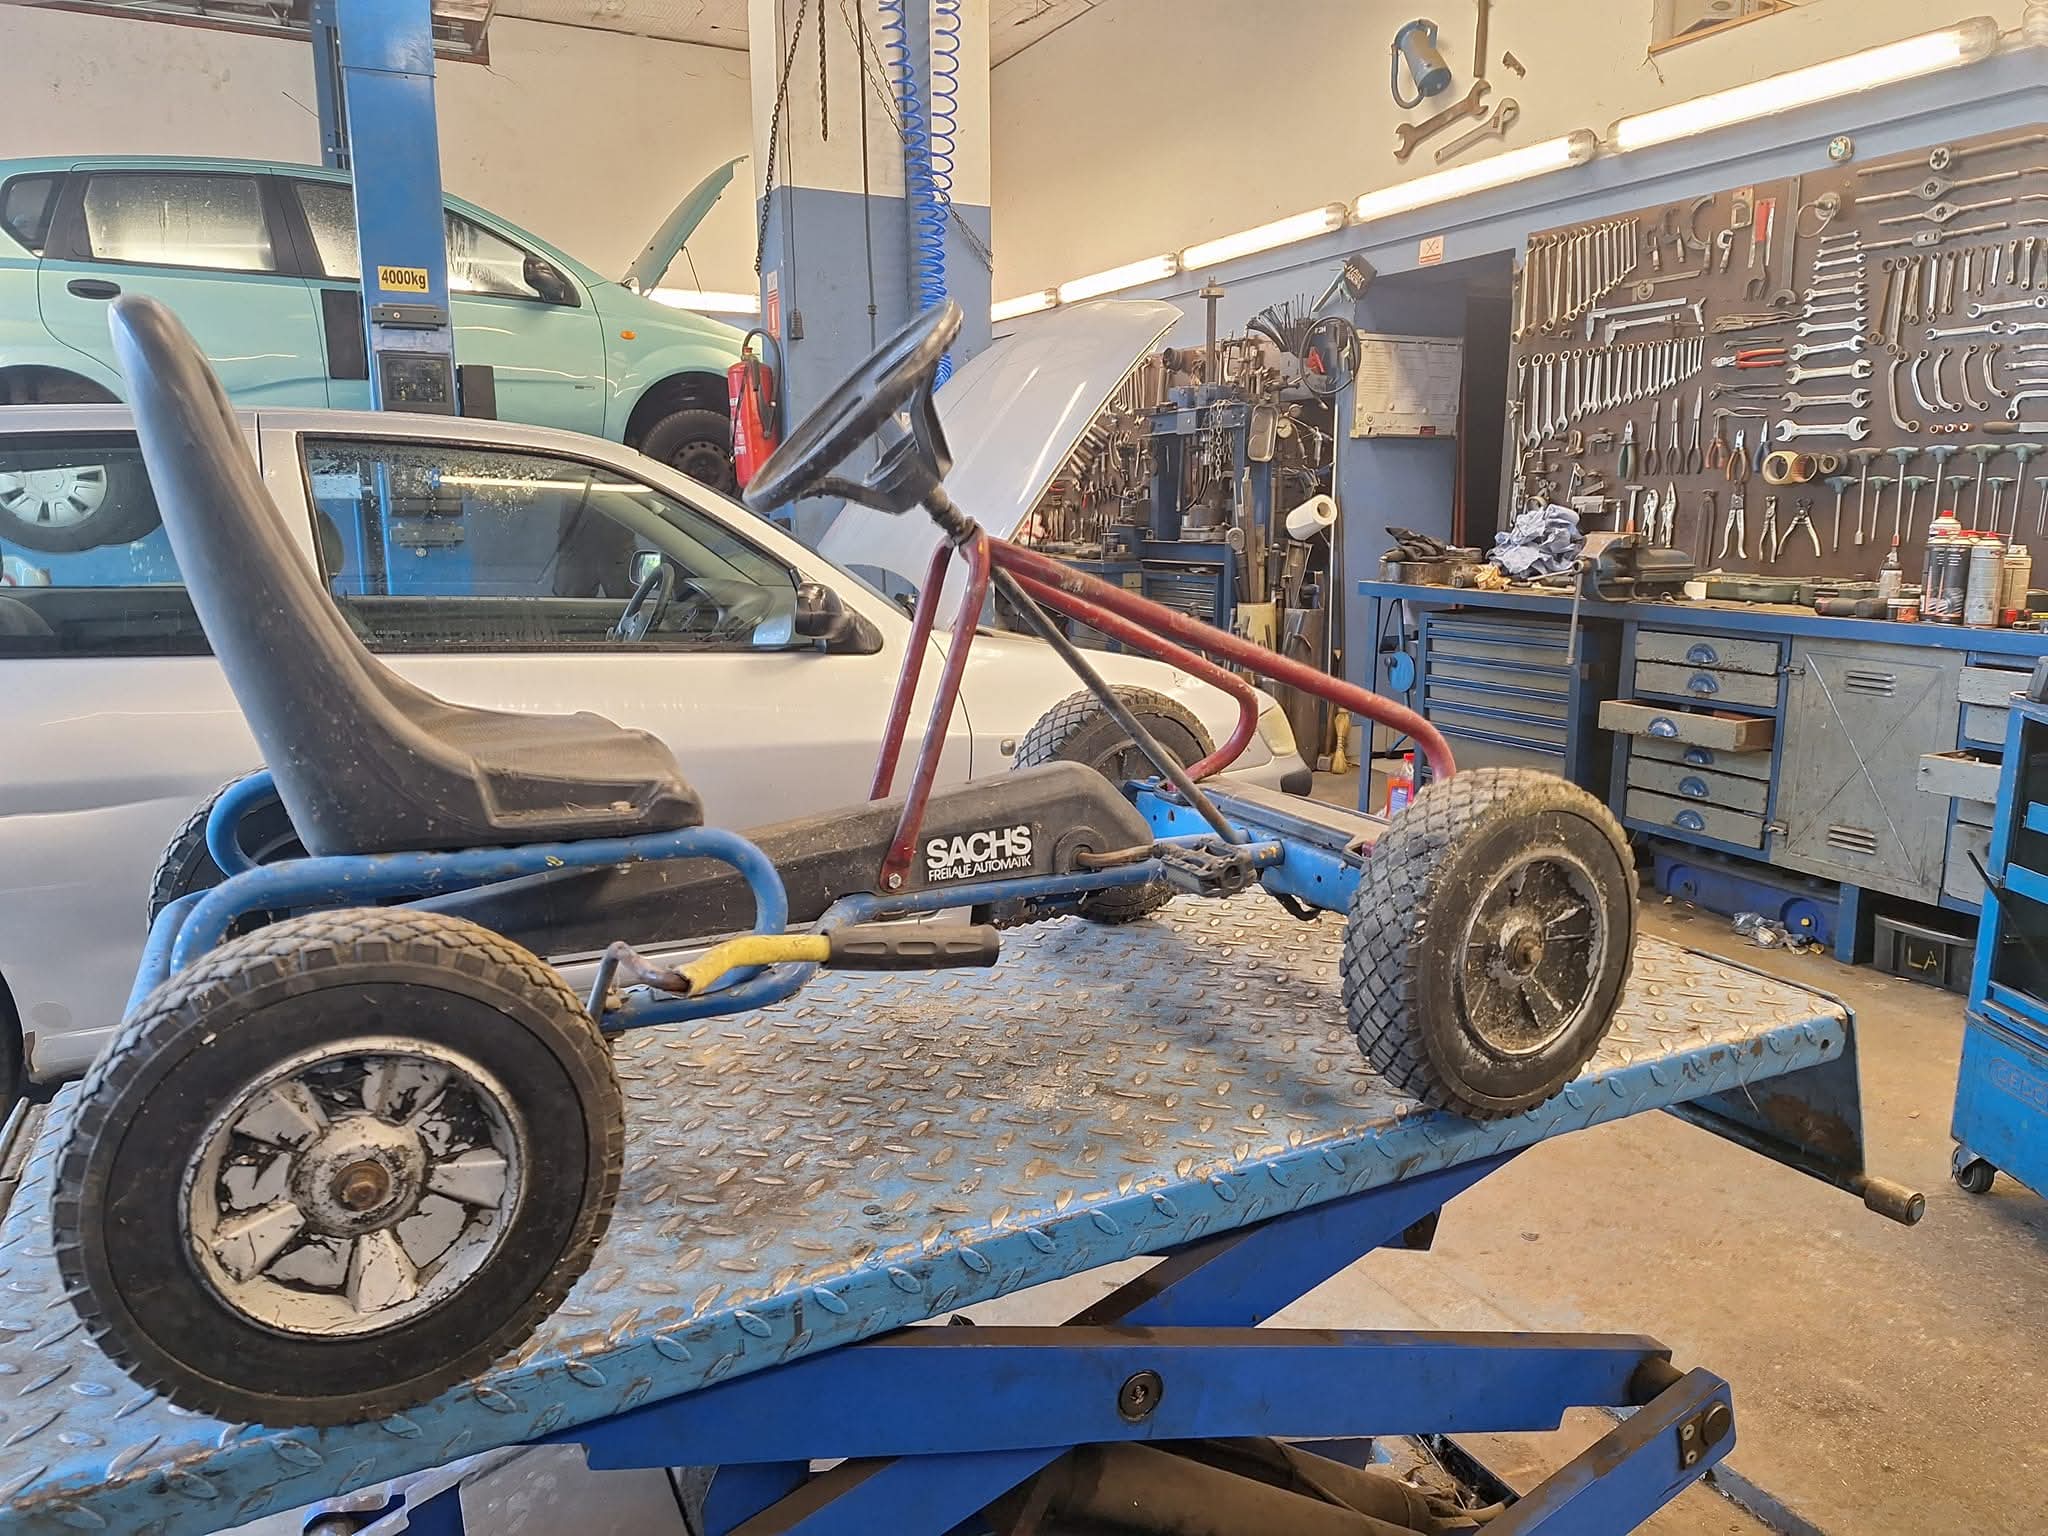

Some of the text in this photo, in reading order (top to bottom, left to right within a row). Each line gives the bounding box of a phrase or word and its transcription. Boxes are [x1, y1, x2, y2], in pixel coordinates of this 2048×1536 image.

[381, 269, 426, 289] 4000kg
[926, 825, 1032, 869] SACHS
[928, 854, 1032, 881] FREILAUF AUTOMATIK
